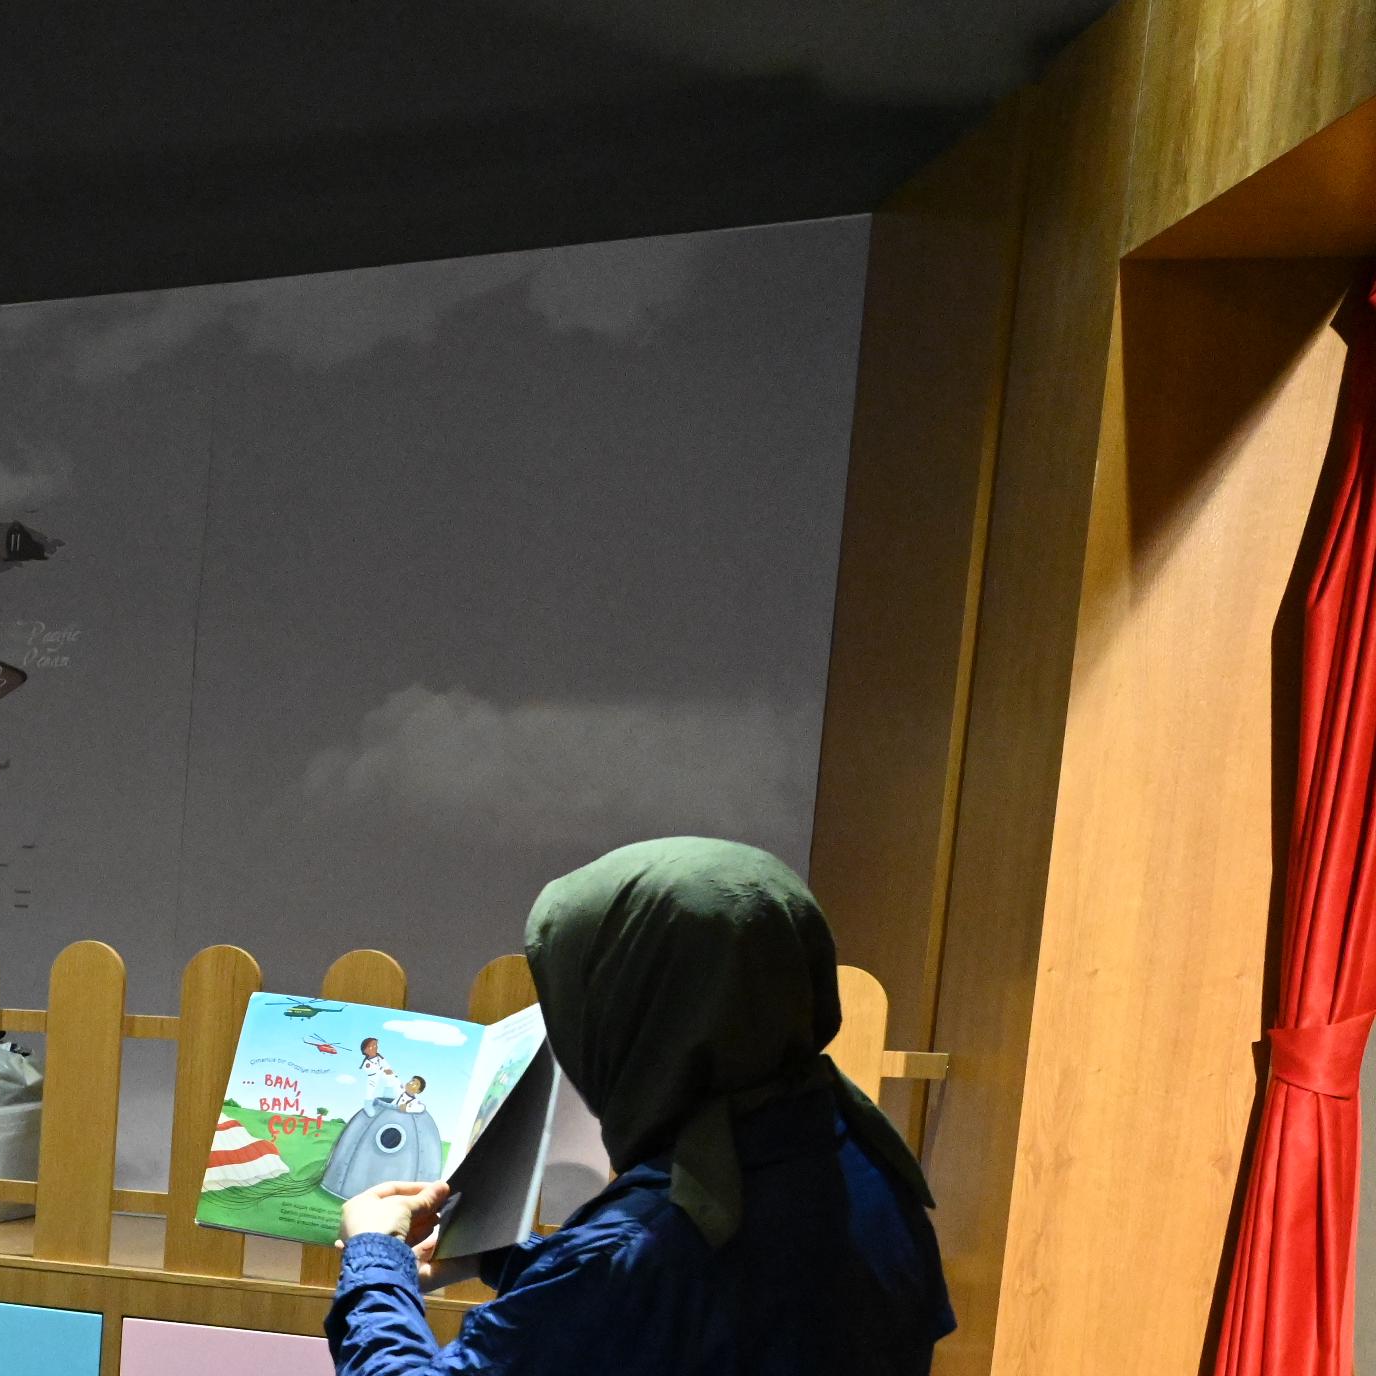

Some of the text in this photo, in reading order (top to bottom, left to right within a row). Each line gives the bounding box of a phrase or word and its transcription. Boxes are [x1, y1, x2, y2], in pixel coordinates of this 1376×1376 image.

[16, 620, 81, 653] Pacific
[23, 647, 70, 668] Ocean
[264, 1074, 301, 1097] BAM,
[259, 1097, 305, 1115] BAM,
[268, 1114, 323, 1142] ÇOT!
